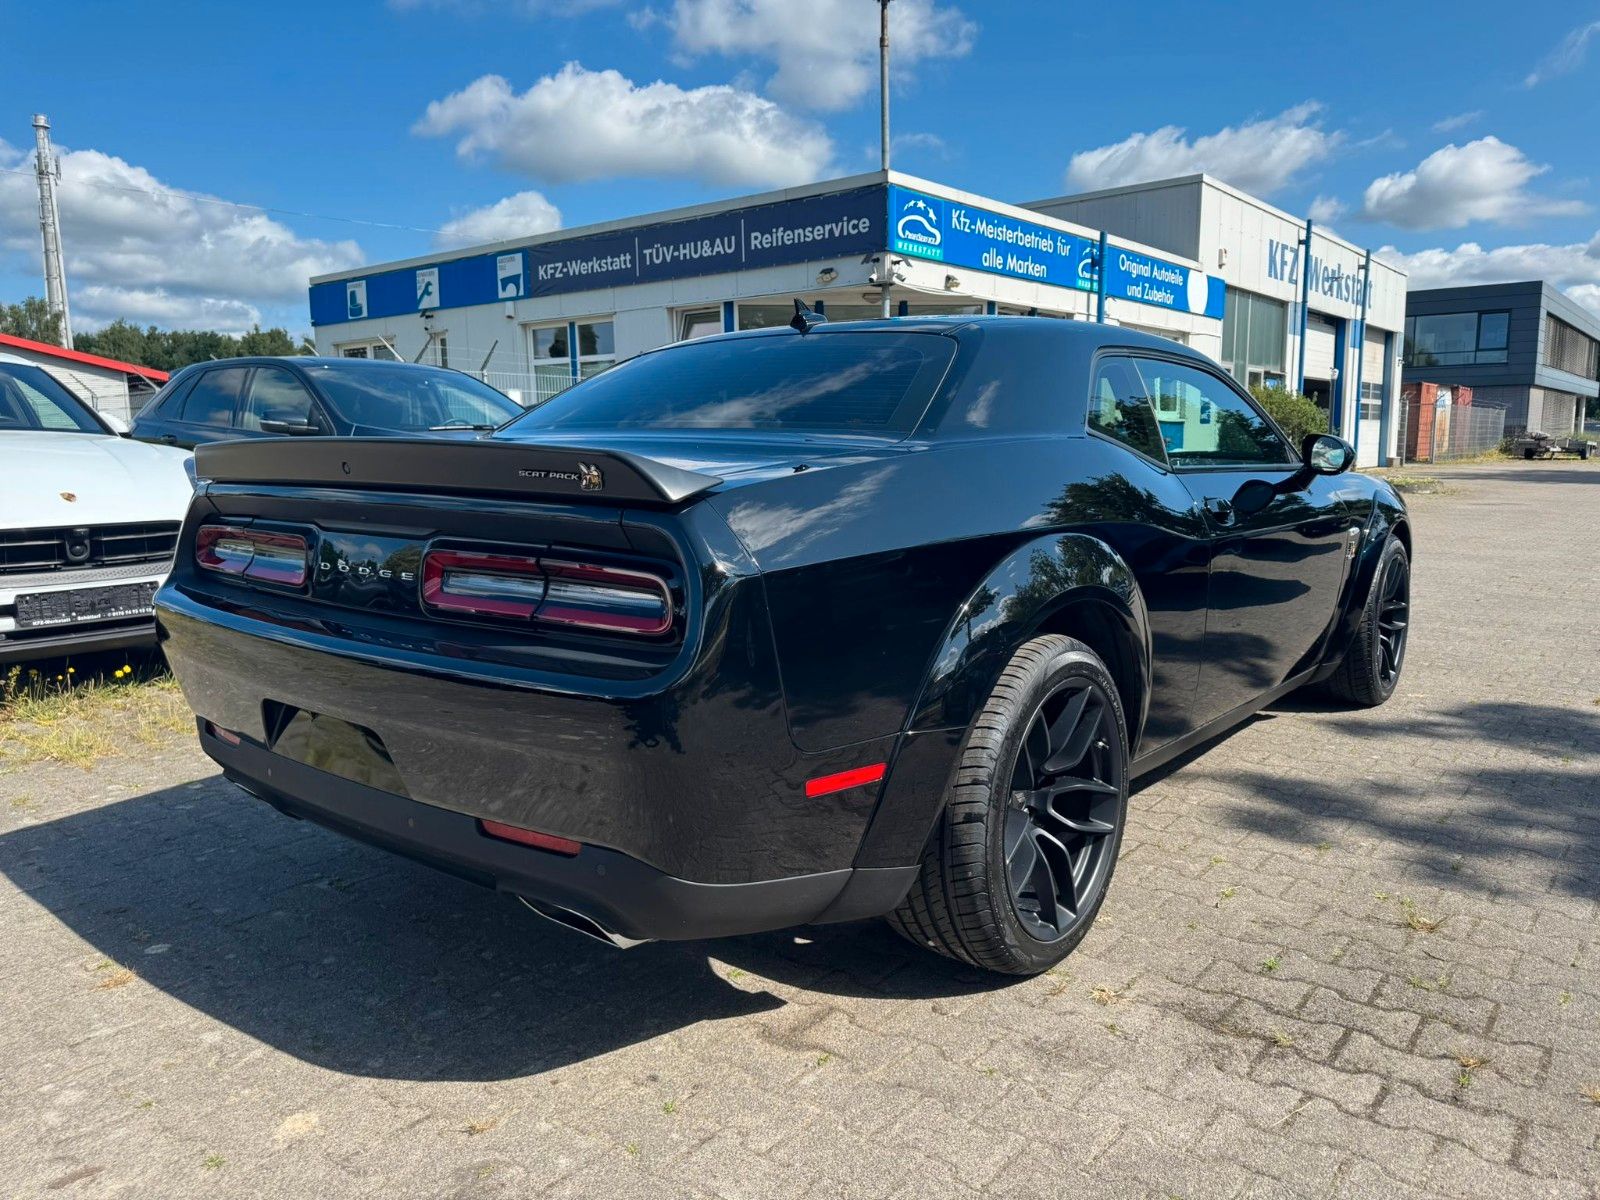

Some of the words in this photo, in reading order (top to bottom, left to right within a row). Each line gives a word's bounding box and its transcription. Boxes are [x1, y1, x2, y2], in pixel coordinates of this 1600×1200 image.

[750, 216, 870, 250] Reifenservice
[951, 208, 1055, 254] Kfz-Meisterbetrieb
[1056, 235, 1072, 257] für
[643, 235, 736, 265] TÜV-HU&AU
[897, 241, 941, 257] WERKSTATT
[981, 247, 1004, 270] alle
[1006, 252, 1048, 278] Marken
[538, 252, 632, 281] KFZ-Werkstatt
[1119, 253, 1151, 278] Original
[1152, 263, 1184, 287] Autoteile
[1267, 238, 1299, 285] KFZ
[1306, 253, 1373, 309] Werkstat
[1126, 281, 1142, 298] und
[1143, 282, 1175, 305] Zubehör
[518, 470, 547, 478] SCAT
[549, 471, 580, 481] PACK
[319, 561, 415, 581] DODGE
